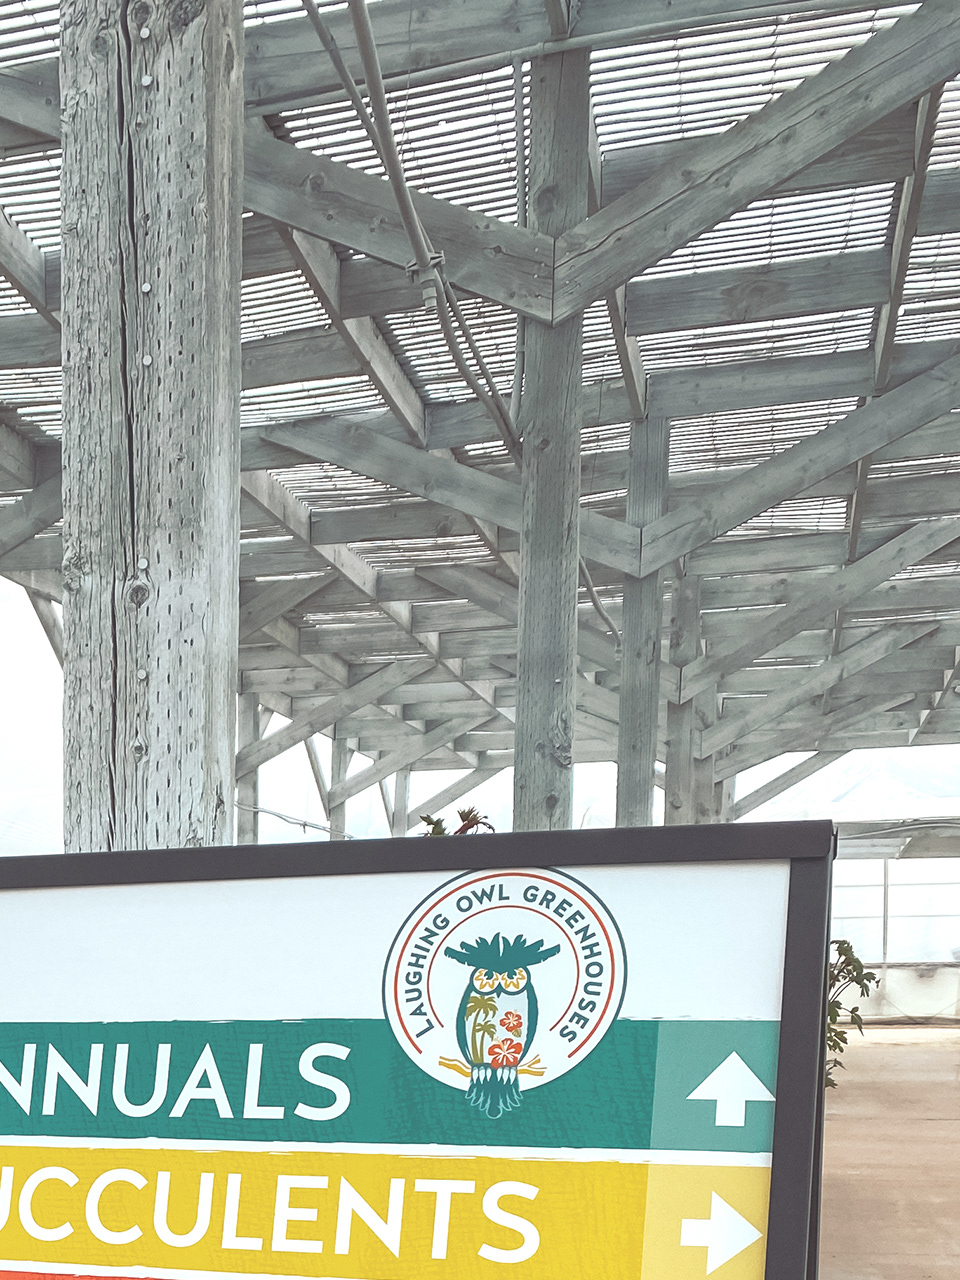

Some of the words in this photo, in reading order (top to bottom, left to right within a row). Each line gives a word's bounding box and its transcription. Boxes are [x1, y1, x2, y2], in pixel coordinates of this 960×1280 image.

[404, 913, 451, 1039] LAUGHING
[456, 884, 510, 913] OWL
[523, 885, 604, 1043] GREENHOUSES
